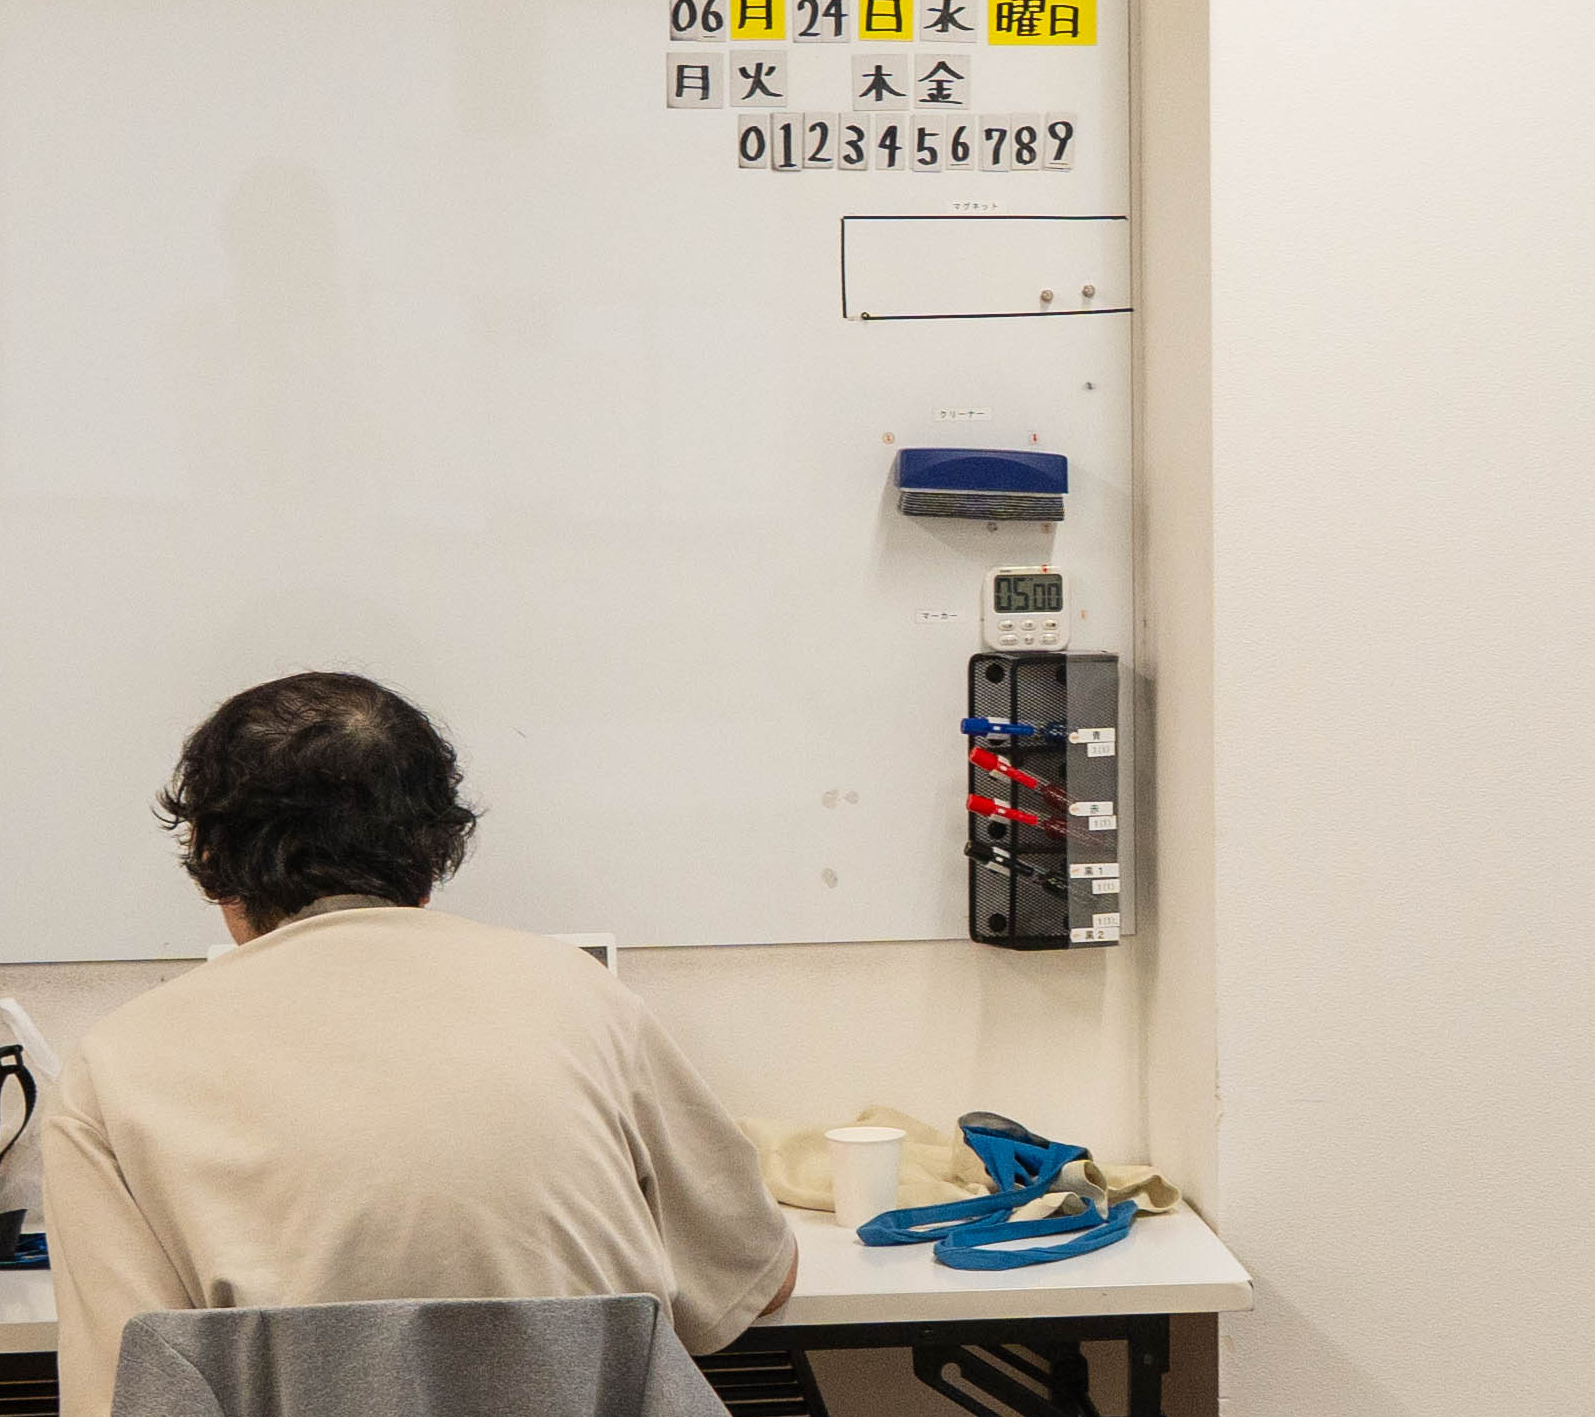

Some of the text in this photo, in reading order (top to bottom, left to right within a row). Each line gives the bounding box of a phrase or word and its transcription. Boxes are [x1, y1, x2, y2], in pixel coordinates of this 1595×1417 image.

[952, 201, 998, 212] マグネット
